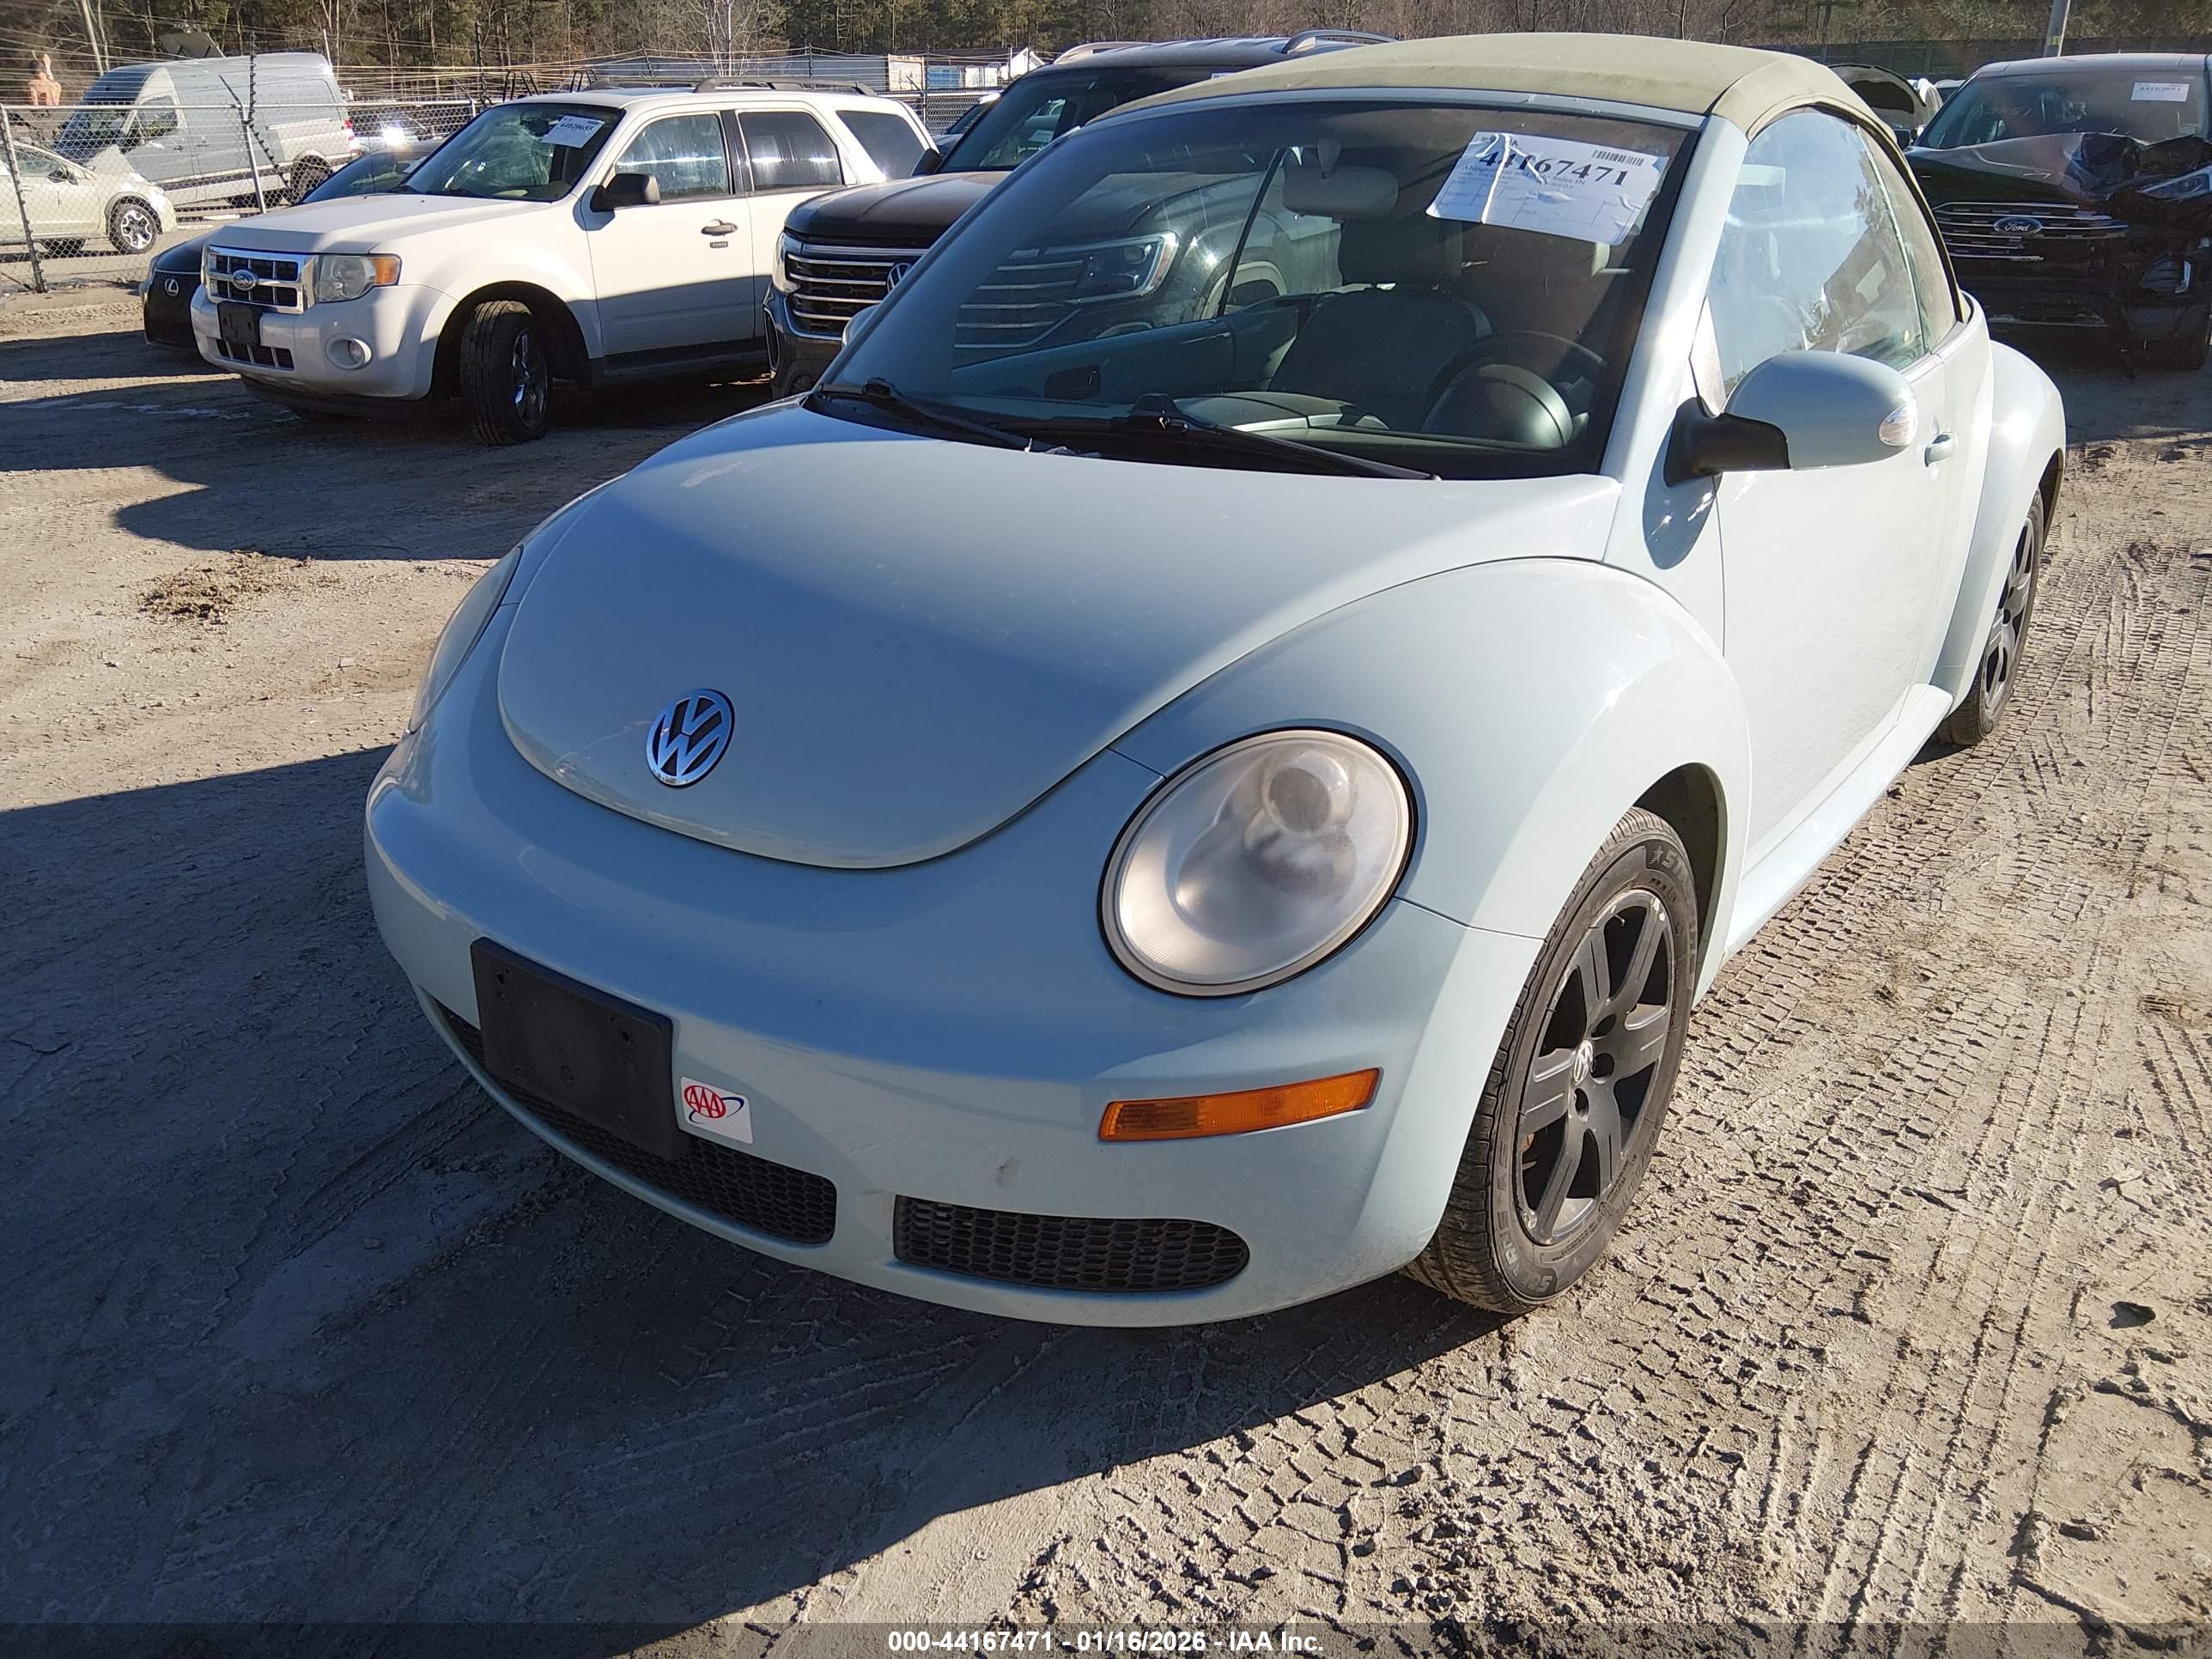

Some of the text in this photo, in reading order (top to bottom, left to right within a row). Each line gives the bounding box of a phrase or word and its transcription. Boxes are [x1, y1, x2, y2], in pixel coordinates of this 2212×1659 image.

[1479, 151, 1629, 186] 44167471
[2004, 222, 2032, 232] Ford
[684, 1085, 726, 1119] AAA
